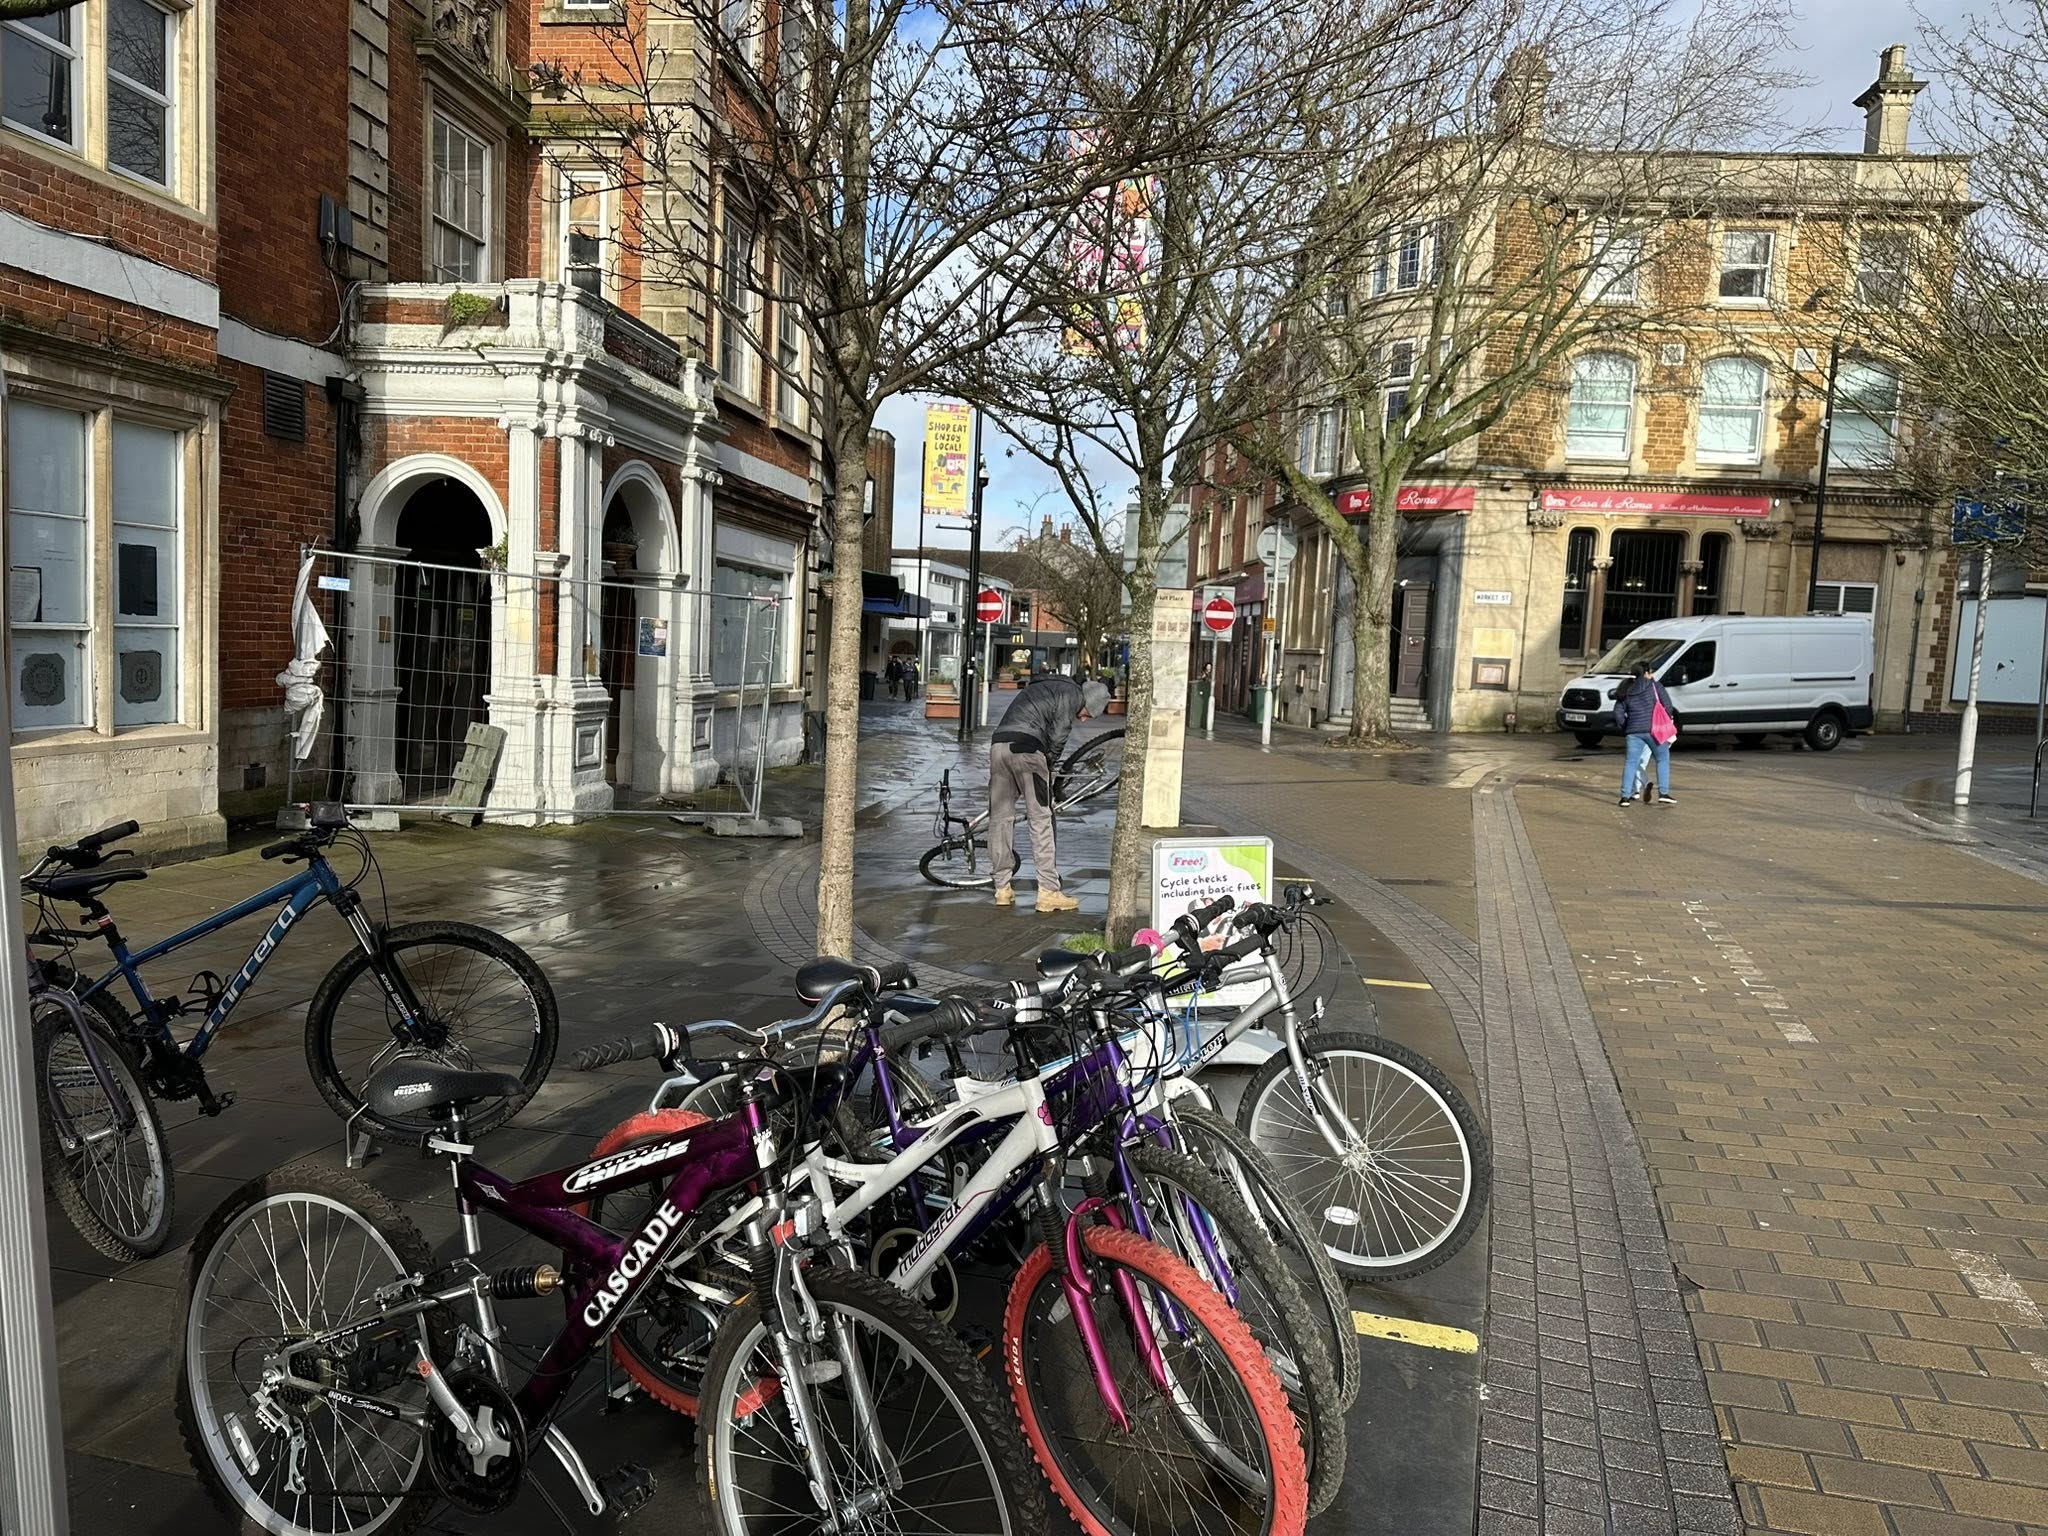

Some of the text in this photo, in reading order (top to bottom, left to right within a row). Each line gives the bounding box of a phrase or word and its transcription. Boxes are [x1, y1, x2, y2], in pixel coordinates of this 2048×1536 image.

[952, 424, 968, 433] EAT
[934, 432, 961, 442] ENJOY
[934, 442, 962, 452] LOCAL!
[1400, 491, 1439, 506] Roma
[1569, 495, 1654, 510] Casa di Roma
[1172, 857, 1204, 867] Free!
[1160, 874, 1228, 890] Cycle checks
[1161, 882, 1262, 898] including basic fixes
[573, 1138, 691, 1190] RIDGE
[579, 1141, 672, 1176] MOUNTAIN
[583, 1199, 684, 1327] CASCADE
[1012, 1337, 1024, 1387] KENDA
[328, 1390, 354, 1405] INDEX
